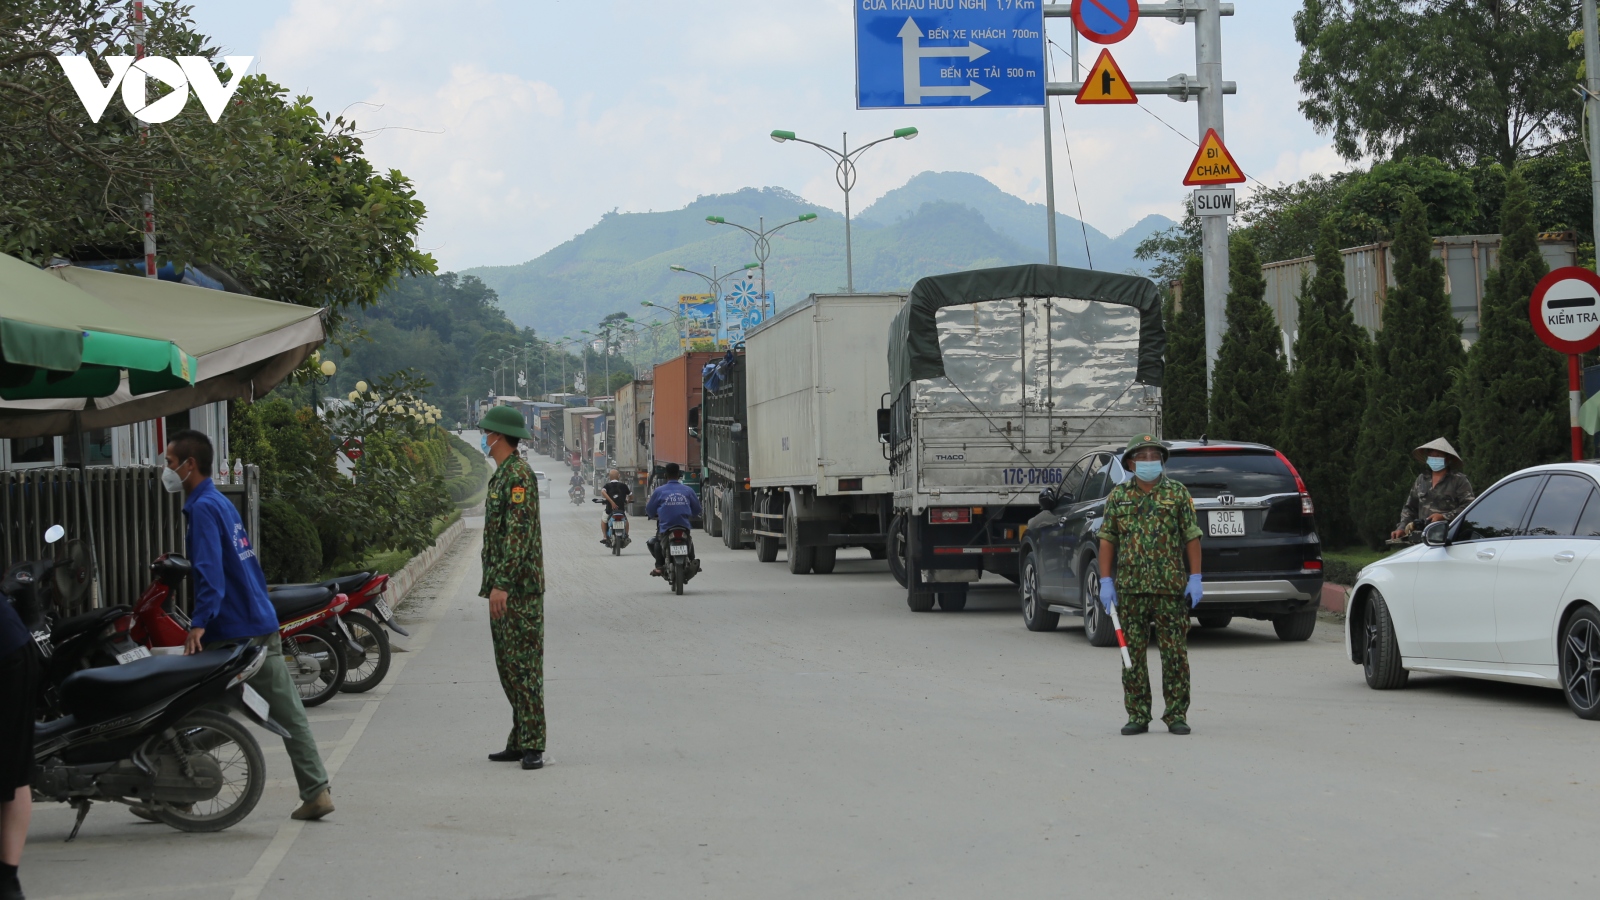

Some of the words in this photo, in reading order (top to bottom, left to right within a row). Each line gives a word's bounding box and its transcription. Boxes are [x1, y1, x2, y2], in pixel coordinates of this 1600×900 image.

[996, 0, 1012, 11] 1,7
[1015, 0, 1035, 9] Km
[928, 26, 949, 39] BẾN
[953, 29, 967, 39] XE
[971, 27, 1006, 39] KHÁCH
[1012, 29, 1039, 39] 700m
[940, 65, 962, 78] BẾN
[966, 68, 980, 78] XE
[984, 65, 1001, 78] TẢI
[1006, 68, 1024, 78] 500
[1206, 148, 1219, 159] ĐI
[1196, 163, 1230, 177] CHẬM
[1197, 194, 1232, 210] SLOW
[1547, 309, 1575, 325] KIỂM
[1576, 312, 1599, 323] TRA
[1216, 511, 1236, 523] 30E
[1210, 523, 1244, 535] 646.44
